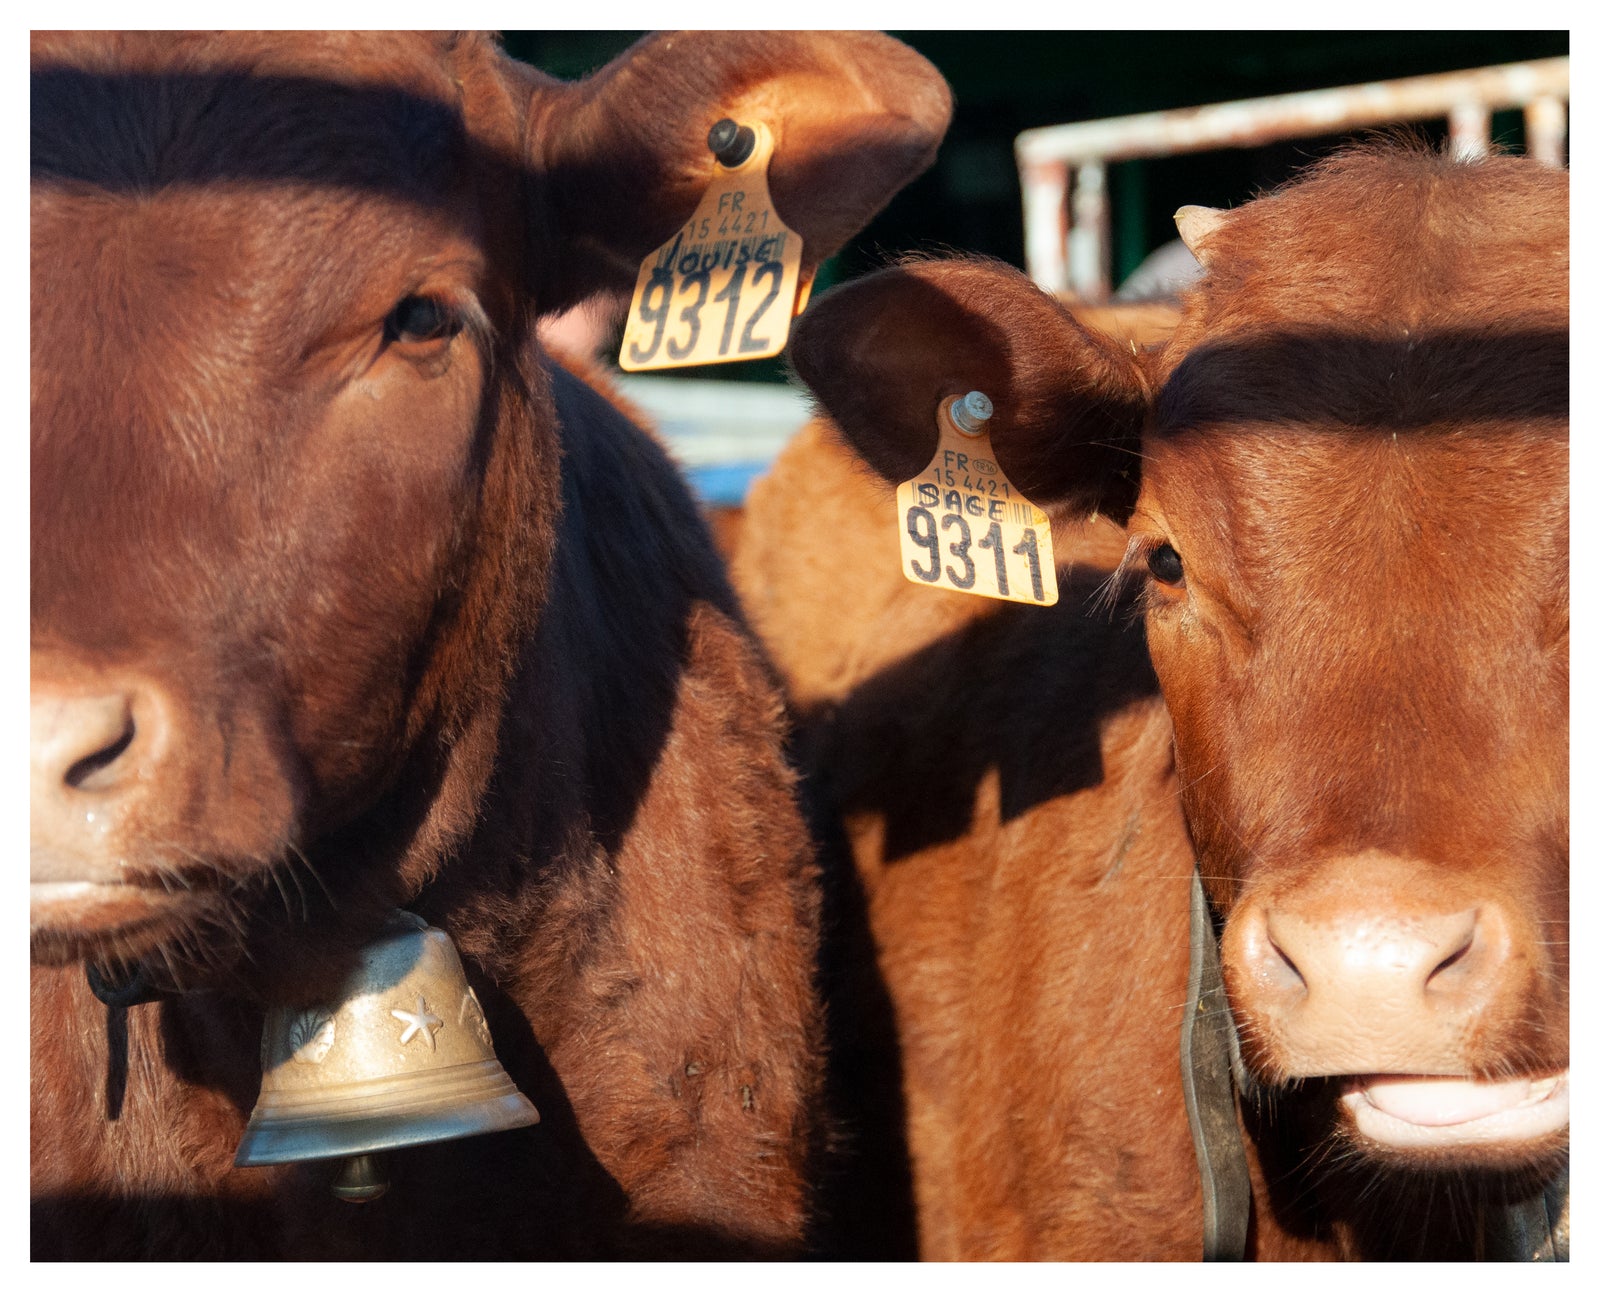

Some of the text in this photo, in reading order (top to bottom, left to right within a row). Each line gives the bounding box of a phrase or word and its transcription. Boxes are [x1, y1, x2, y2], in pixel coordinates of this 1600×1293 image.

[717, 191, 745, 214] FR
[689, 210, 769, 240] 15 4421
[629, 261, 784, 364] 9312
[943, 450, 969, 472] FR
[934, 467, 1010, 499] 15 4421
[917, 483, 1006, 522] SAGE
[906, 505, 1045, 601] 9311
